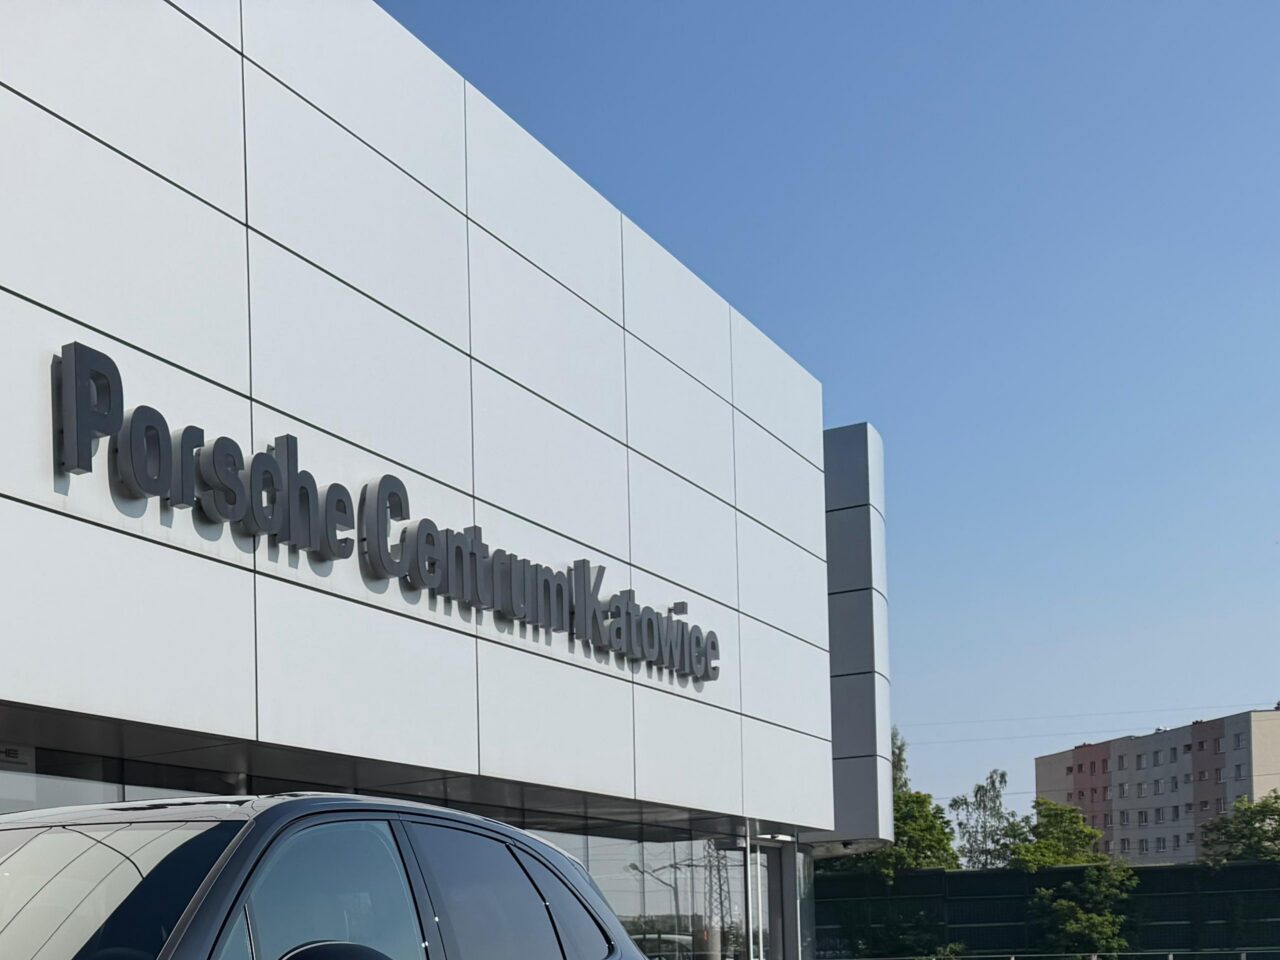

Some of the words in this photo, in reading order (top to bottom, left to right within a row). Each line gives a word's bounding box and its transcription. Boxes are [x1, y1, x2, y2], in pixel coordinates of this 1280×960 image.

[60, 340, 355, 560] Porsche
[363, 474, 571, 634] Centrum
[573, 559, 720, 682] Katowice
